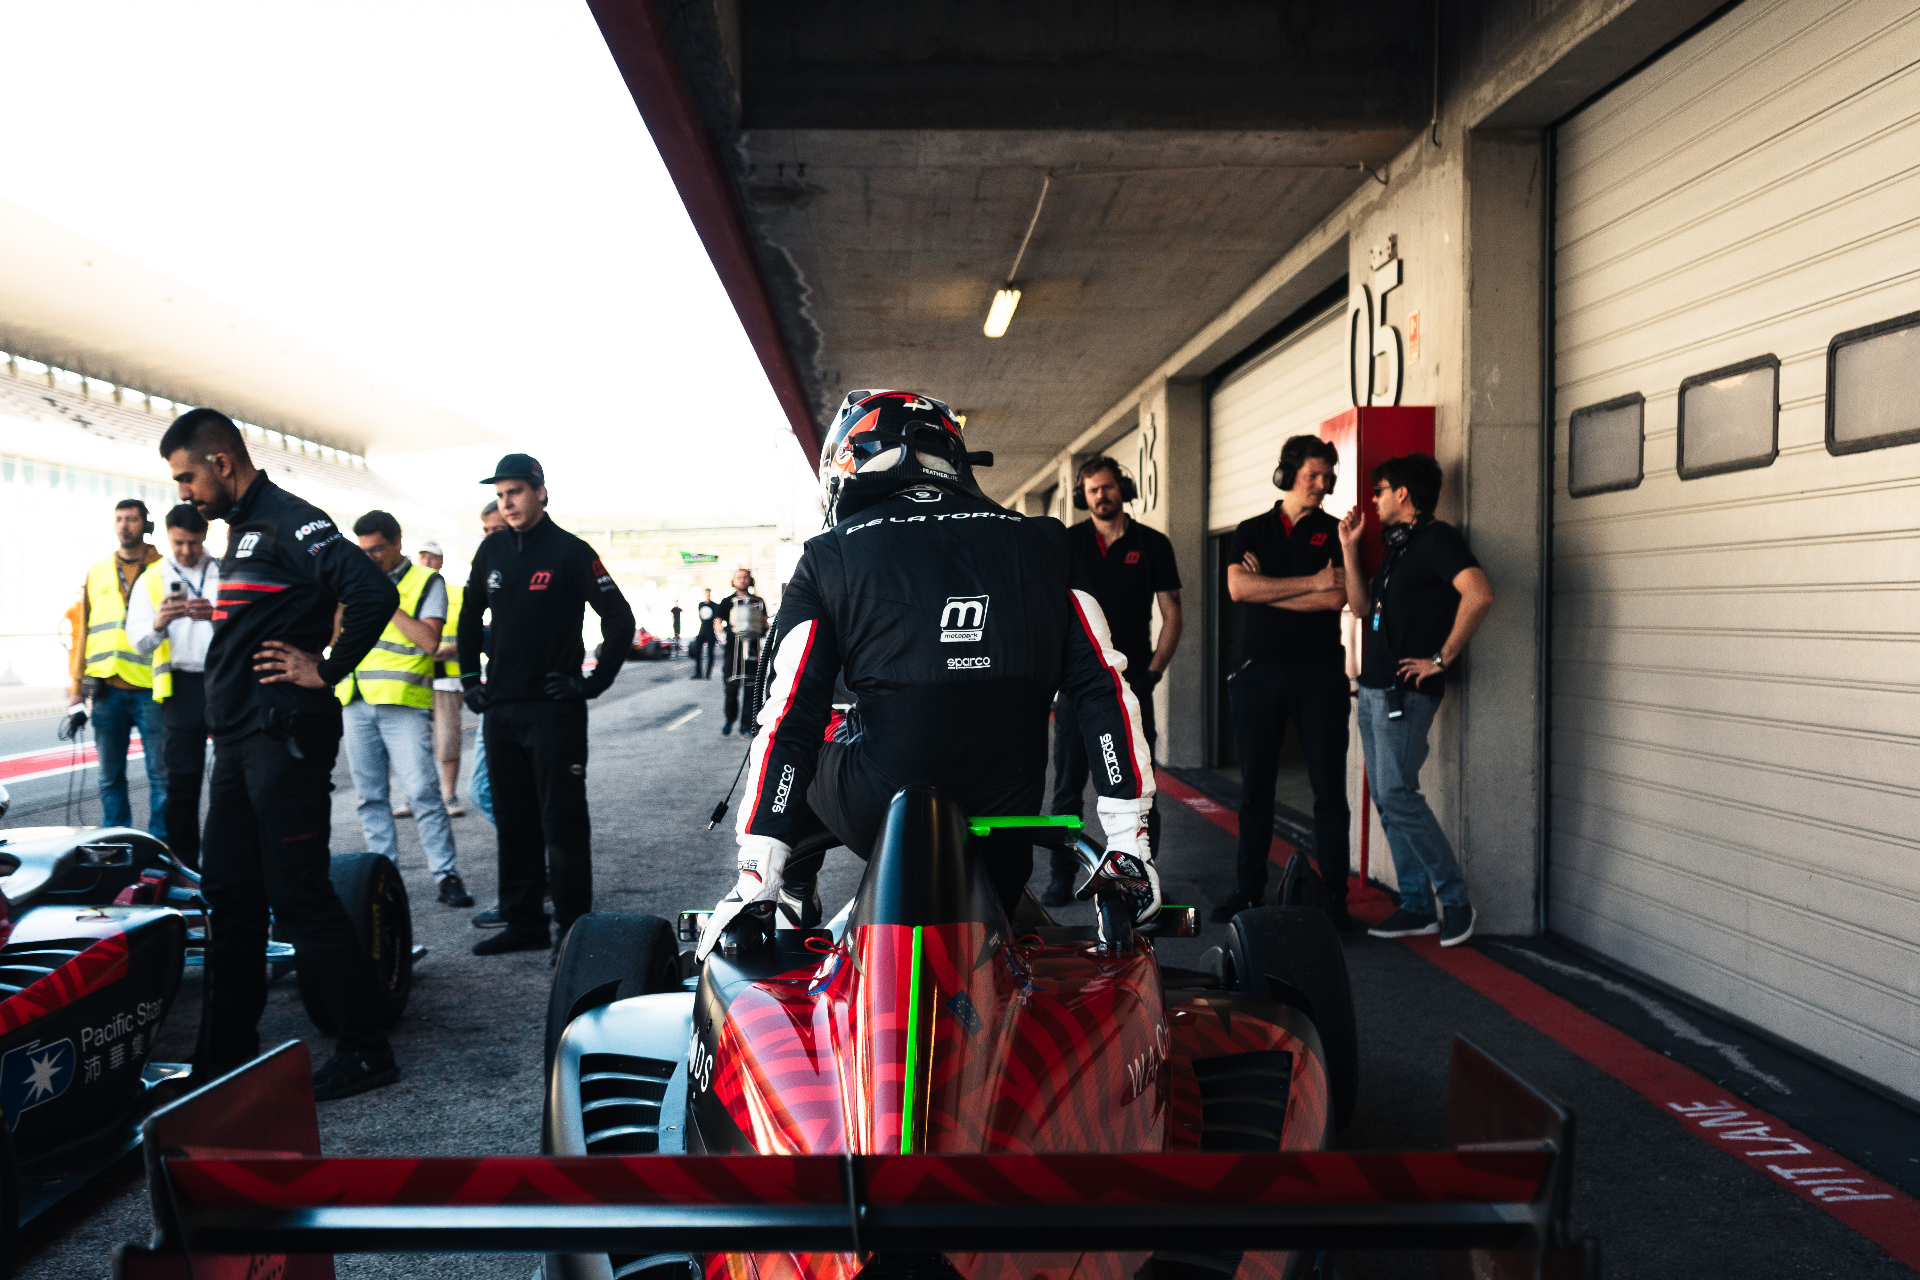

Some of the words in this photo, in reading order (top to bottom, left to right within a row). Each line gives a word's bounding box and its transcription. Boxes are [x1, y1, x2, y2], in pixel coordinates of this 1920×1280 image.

[1346, 258, 1403, 407] 05
[846, 518, 883, 535] DE
[890, 515, 926, 523] LA
[947, 657, 991, 670] sparco
[1100, 733, 1122, 785] sparco
[772, 764, 795, 813] sparco
[81, 1012, 133, 1052] Pacific
[136, 999, 162, 1026] Star
[1667, 1100, 1812, 1156] LANE
[1766, 1164, 1893, 1202] PIT
